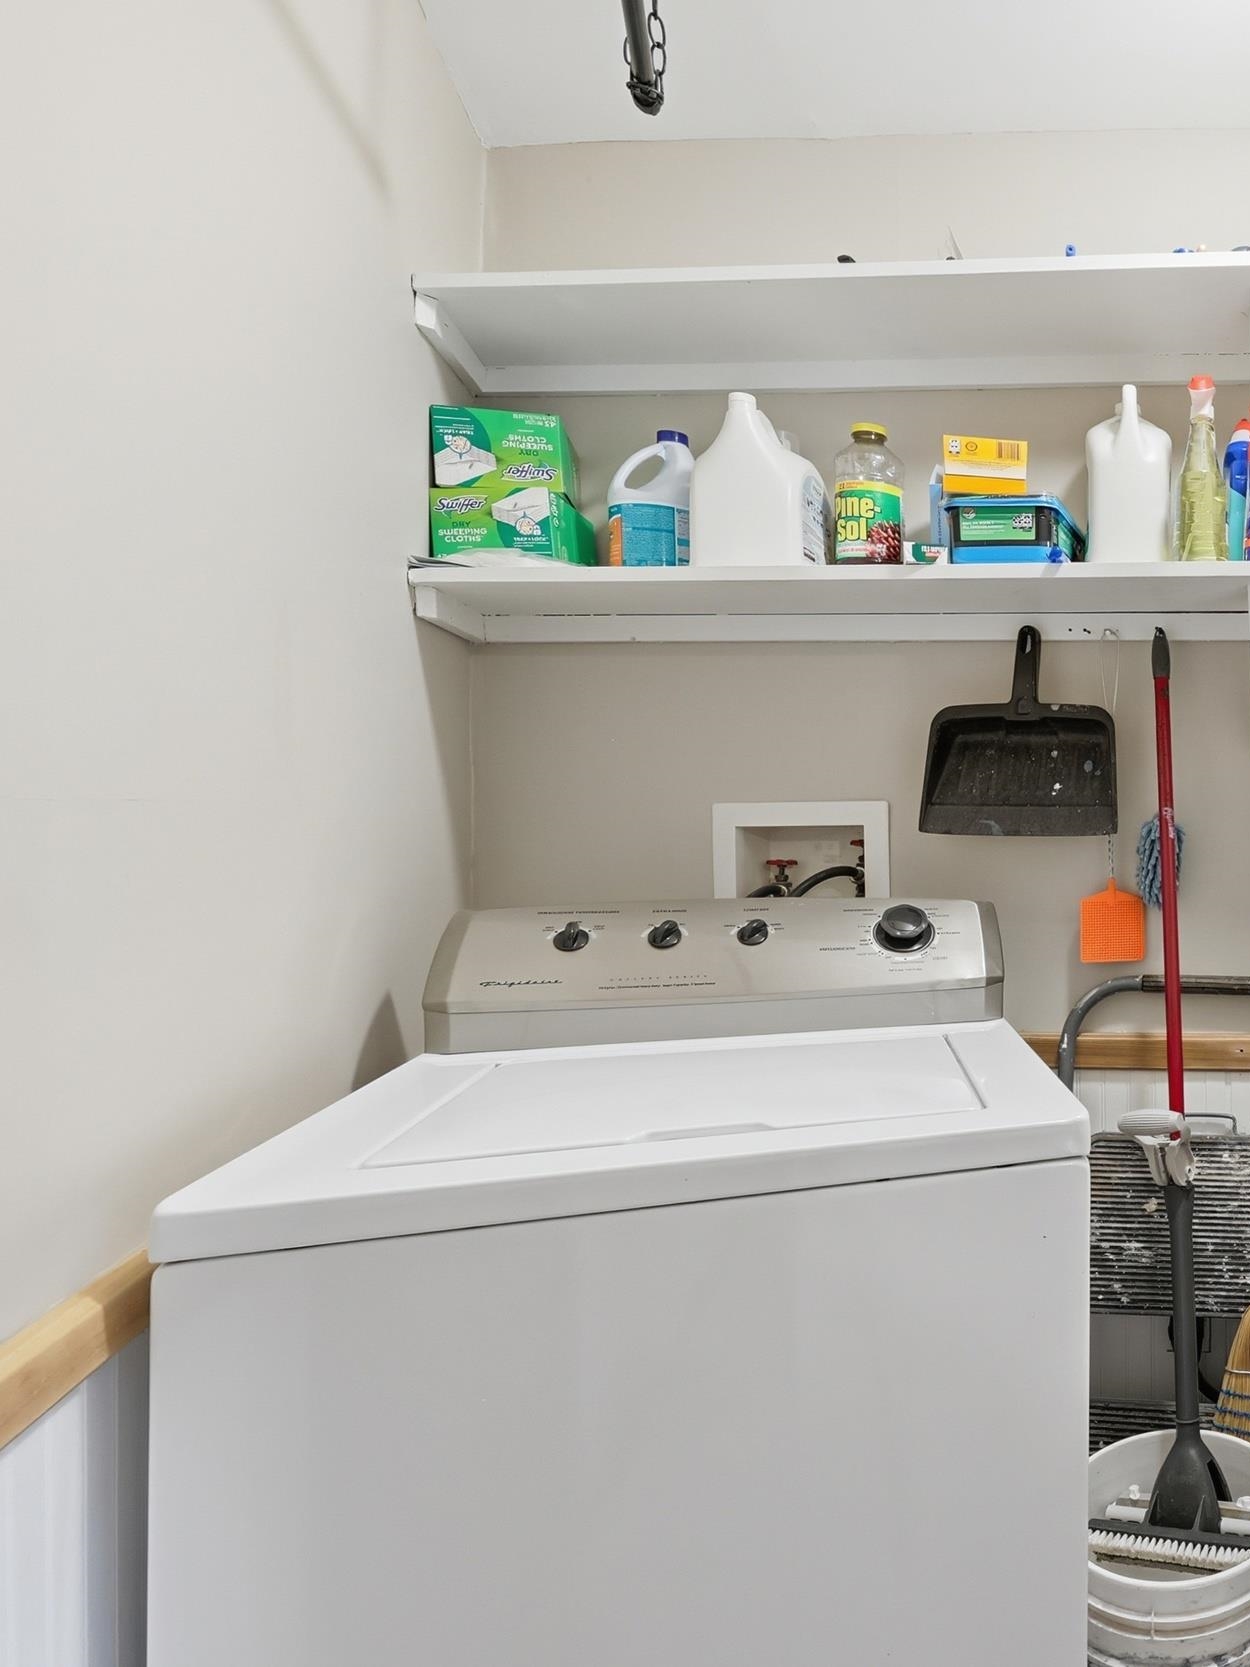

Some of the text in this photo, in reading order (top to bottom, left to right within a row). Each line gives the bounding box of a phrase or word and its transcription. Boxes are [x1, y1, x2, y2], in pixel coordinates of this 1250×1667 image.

[505, 463, 557, 481] Swiffer
[435, 498, 486, 513] Swiffer
[438, 527, 488, 536] SWEEPING
[444, 535, 481, 543] CLOTHS
